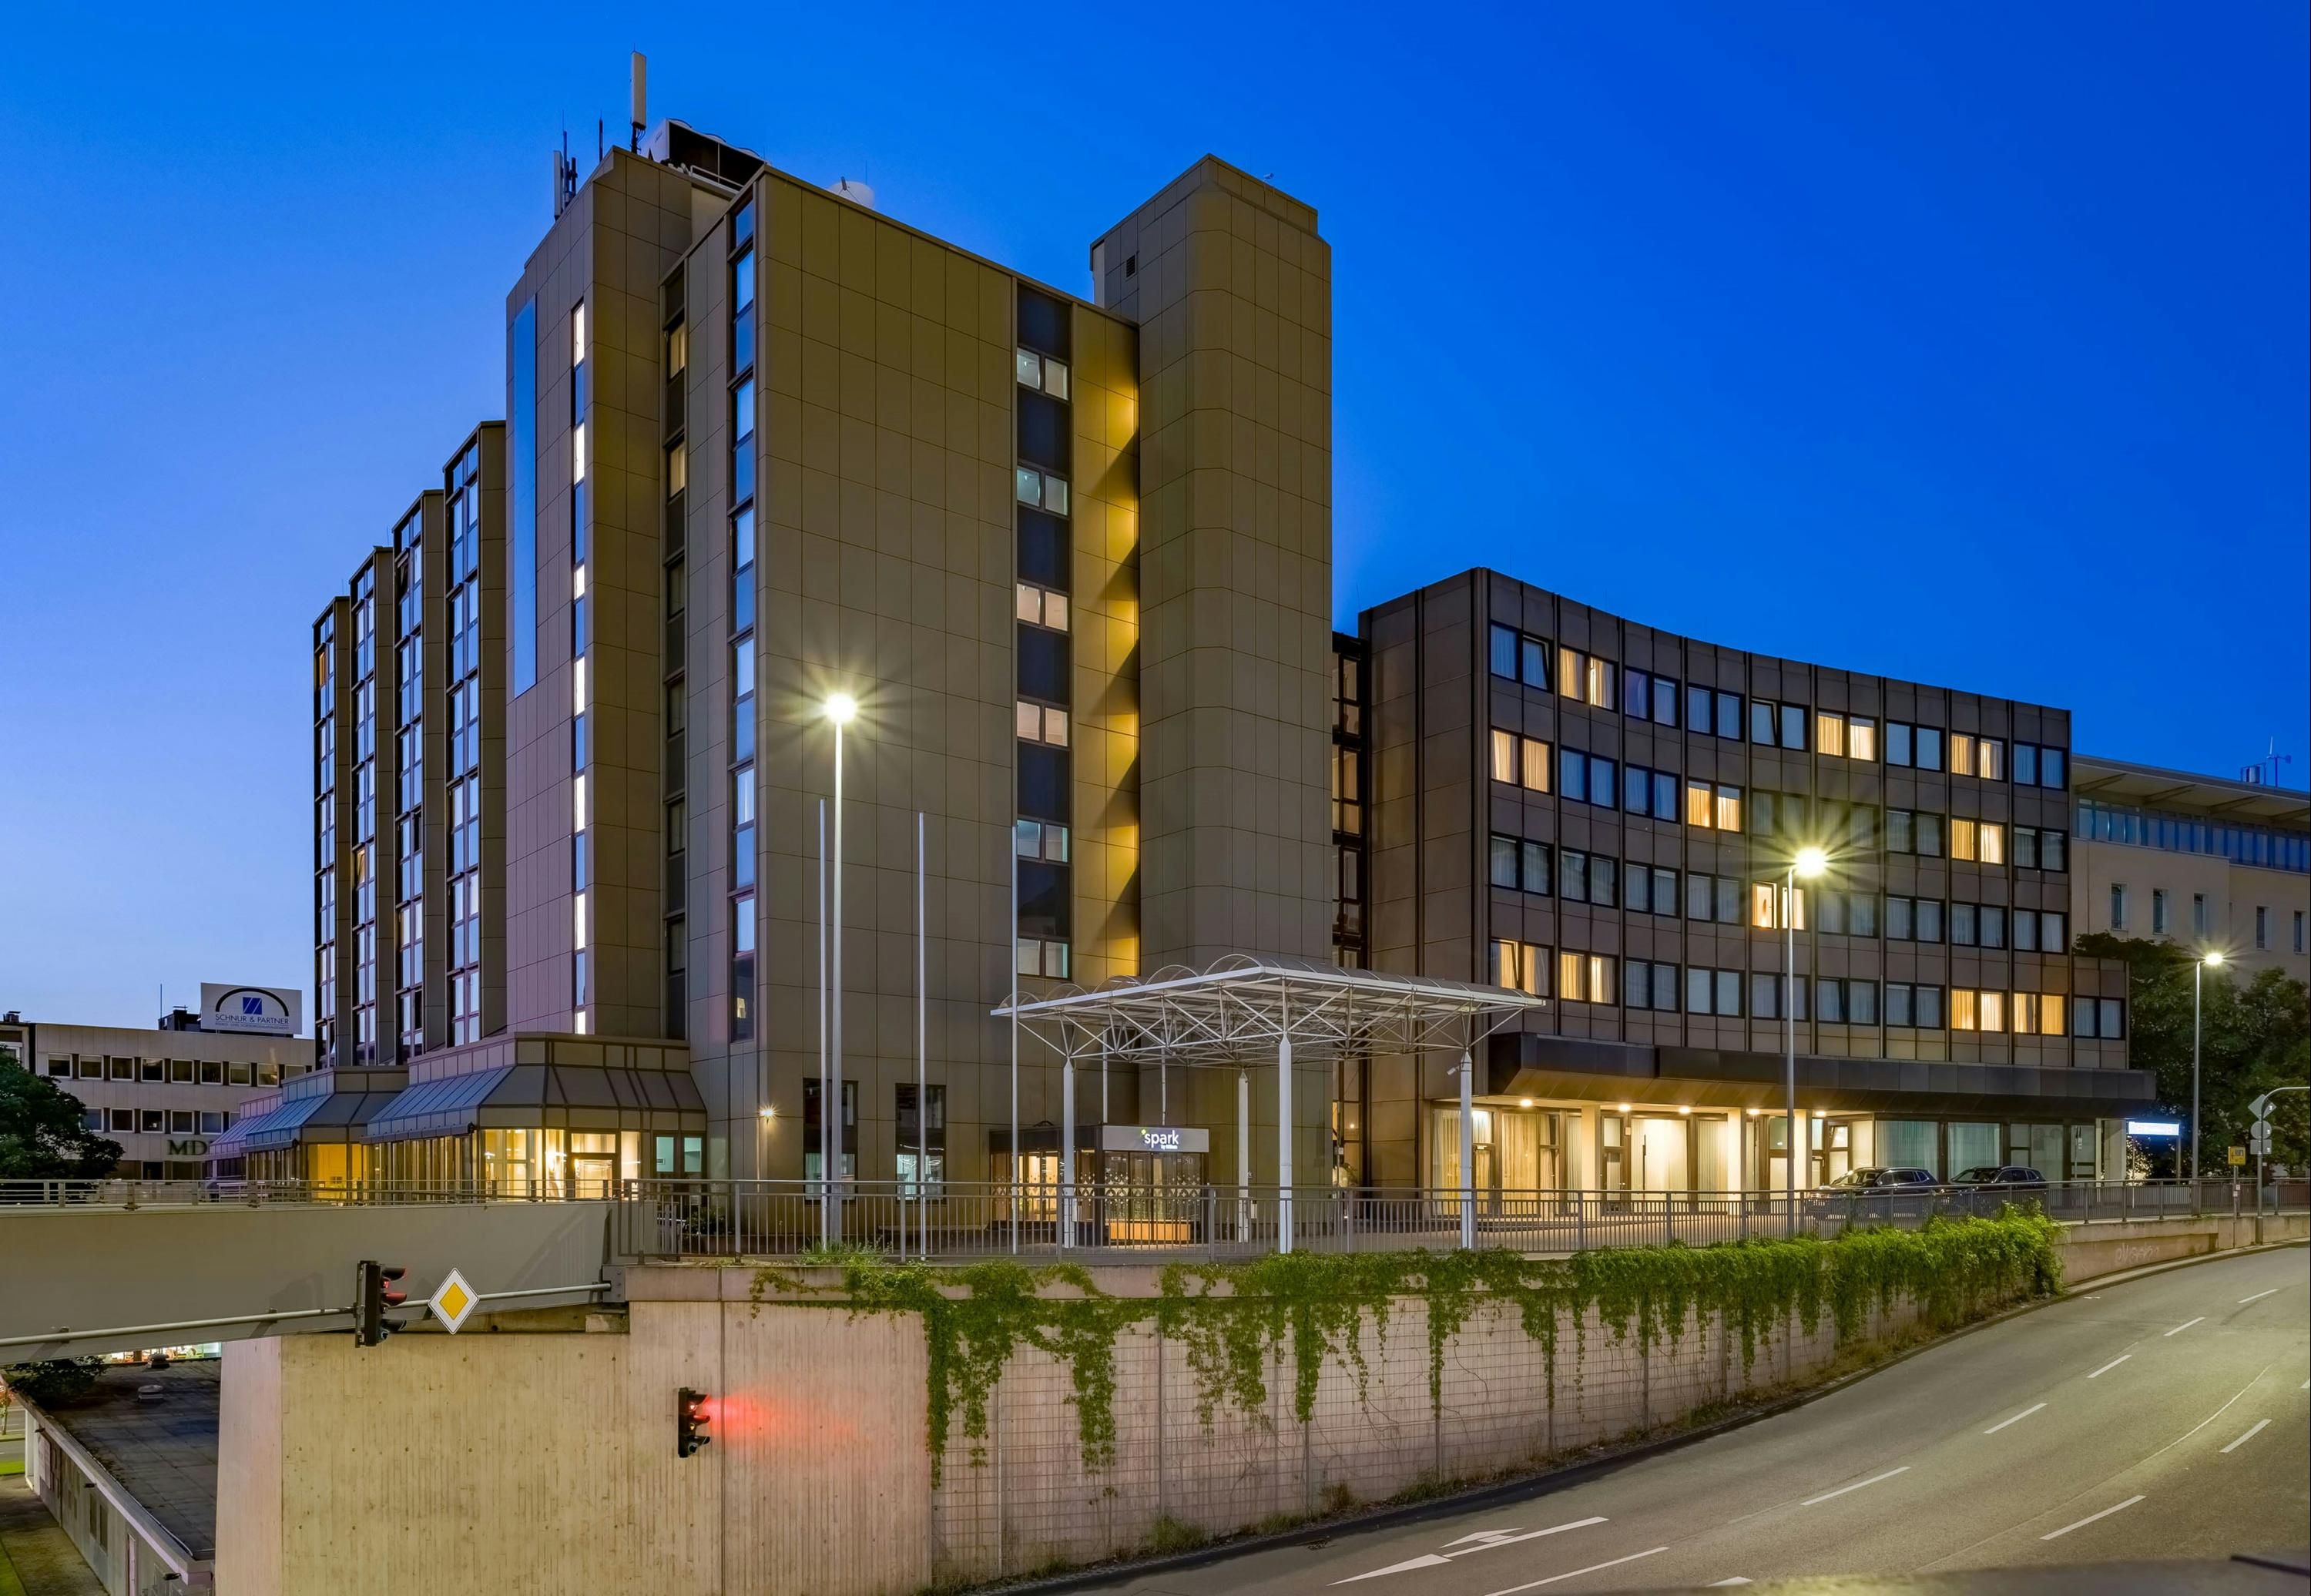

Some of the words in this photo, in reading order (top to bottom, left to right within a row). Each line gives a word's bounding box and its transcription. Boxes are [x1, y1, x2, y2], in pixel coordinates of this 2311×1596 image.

[216, 1014, 247, 1022] SCHNUR
[257, 1016, 289, 1024] PARTNER
[167, 1139, 212, 1155] MD
[1145, 1130, 1179, 1148] spark
